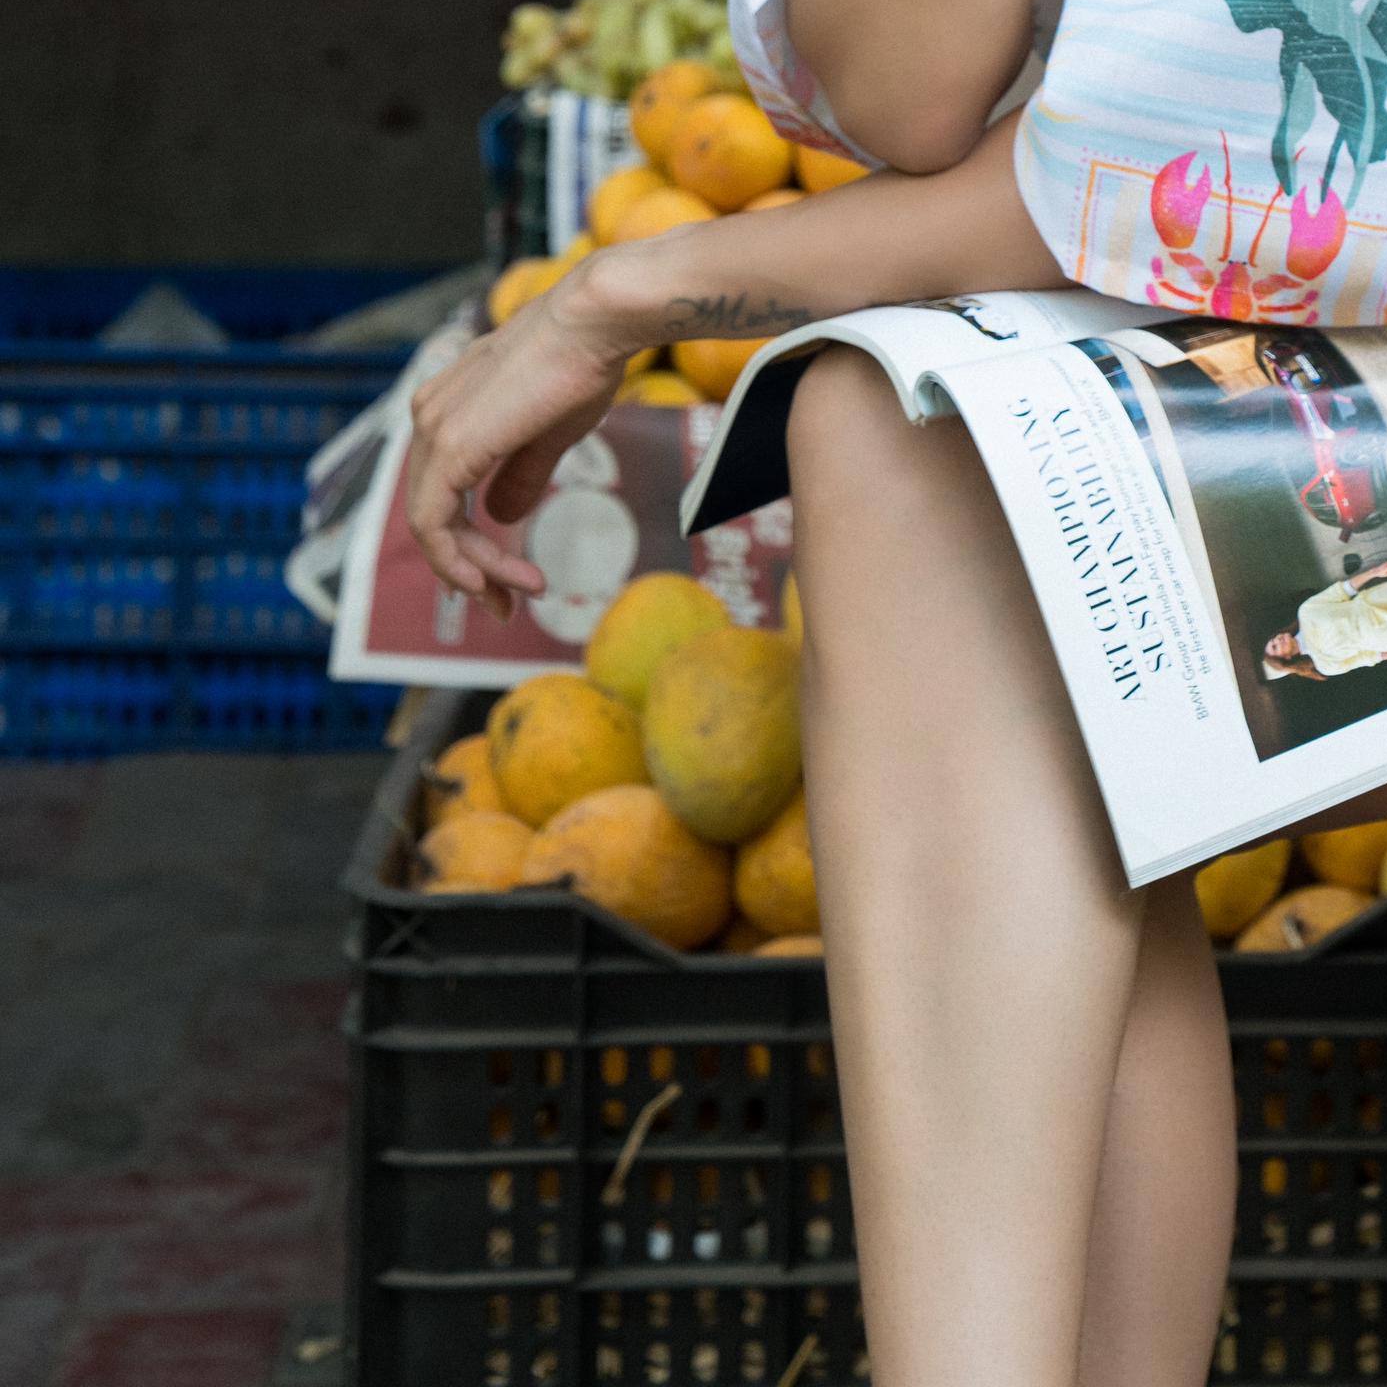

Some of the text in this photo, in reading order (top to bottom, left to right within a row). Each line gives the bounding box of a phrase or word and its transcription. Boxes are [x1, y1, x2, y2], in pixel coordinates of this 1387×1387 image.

[1106, 461, 1133, 510] homage
[1128, 479, 1148, 504] first
[1006, 395, 1121, 635] CHAMPIONING
[1127, 511, 1144, 534] pay
[1140, 505, 1157, 526] the
[1051, 401, 1173, 675] SUSTAINABILITY
[1134, 535, 1153, 560] Fair
[1149, 527, 1165, 545] for
[1144, 561, 1161, 582] Art
[1160, 546, 1177, 574] wrap
[1152, 583, 1172, 614] India
[1171, 578, 1184, 596] car
[1163, 615, 1181, 638] and
[1175, 599, 1203, 653] first-ever
[1103, 636, 1147, 705] ART
[1171, 639, 1196, 681] Group
[1194, 654, 1211, 675] the
[1185, 680, 1210, 722] BMW
